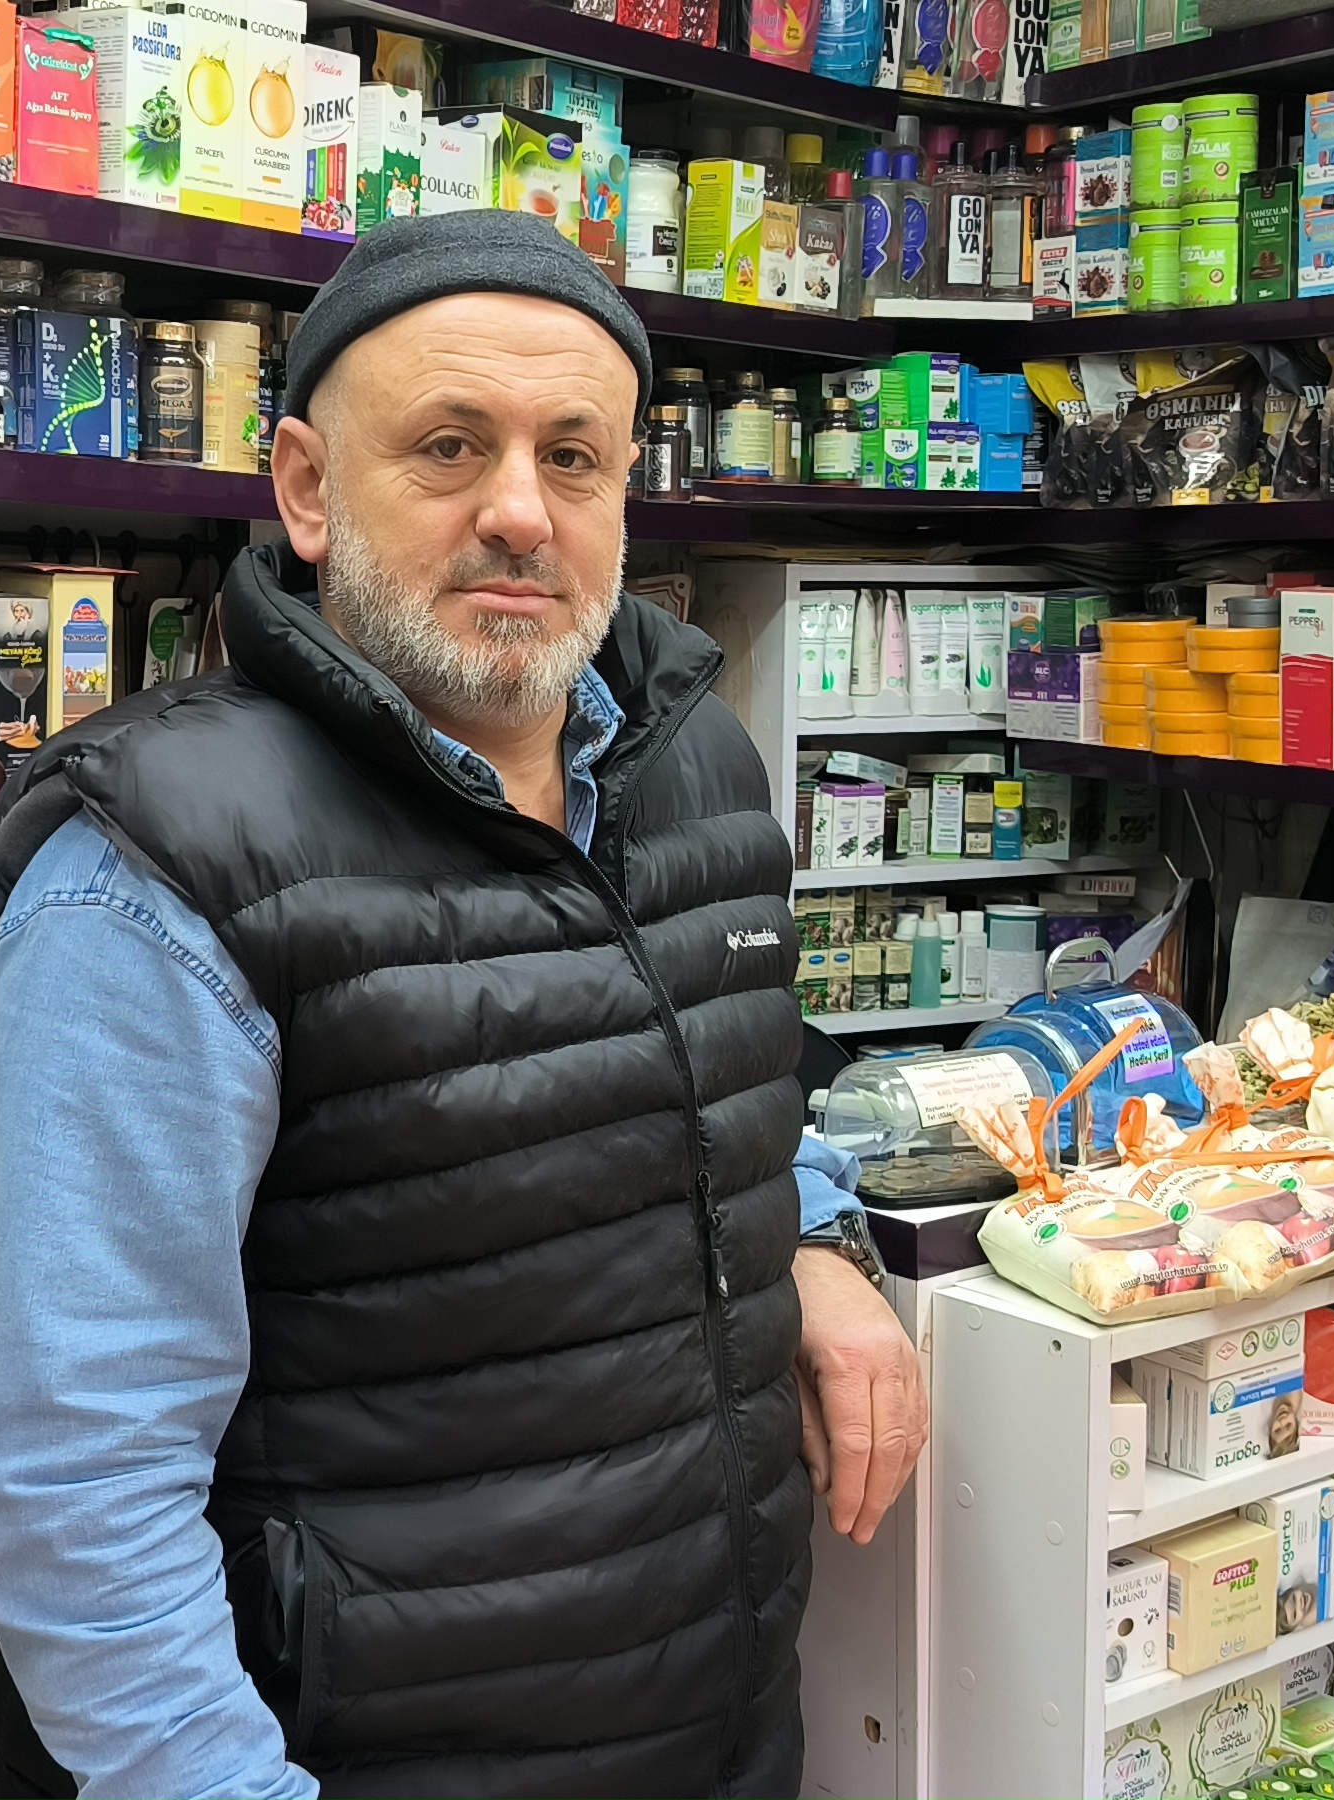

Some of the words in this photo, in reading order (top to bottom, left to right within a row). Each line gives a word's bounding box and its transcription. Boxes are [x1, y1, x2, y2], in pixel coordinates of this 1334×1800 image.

[188, 5, 238, 28] CADOMIN
[147, 20, 168, 40] LEDA
[250, 20, 299, 43] CADOMIN
[1013, 20, 1049, 46] LON
[1015, 50, 1046, 78] YA
[419, 173, 480, 200] COLLAGEN
[959, 196, 982, 218] GO
[957, 218, 983, 239] LON
[959, 234, 981, 255] YA
[1288, 615, 1319, 628] PEPPER
[736, 927, 781, 948] Columbia
[1215, 1442, 1261, 1468] agarta
[1229, 1573, 1257, 1593] PLUS
[1112, 1588, 1148, 1608] SABUNU
